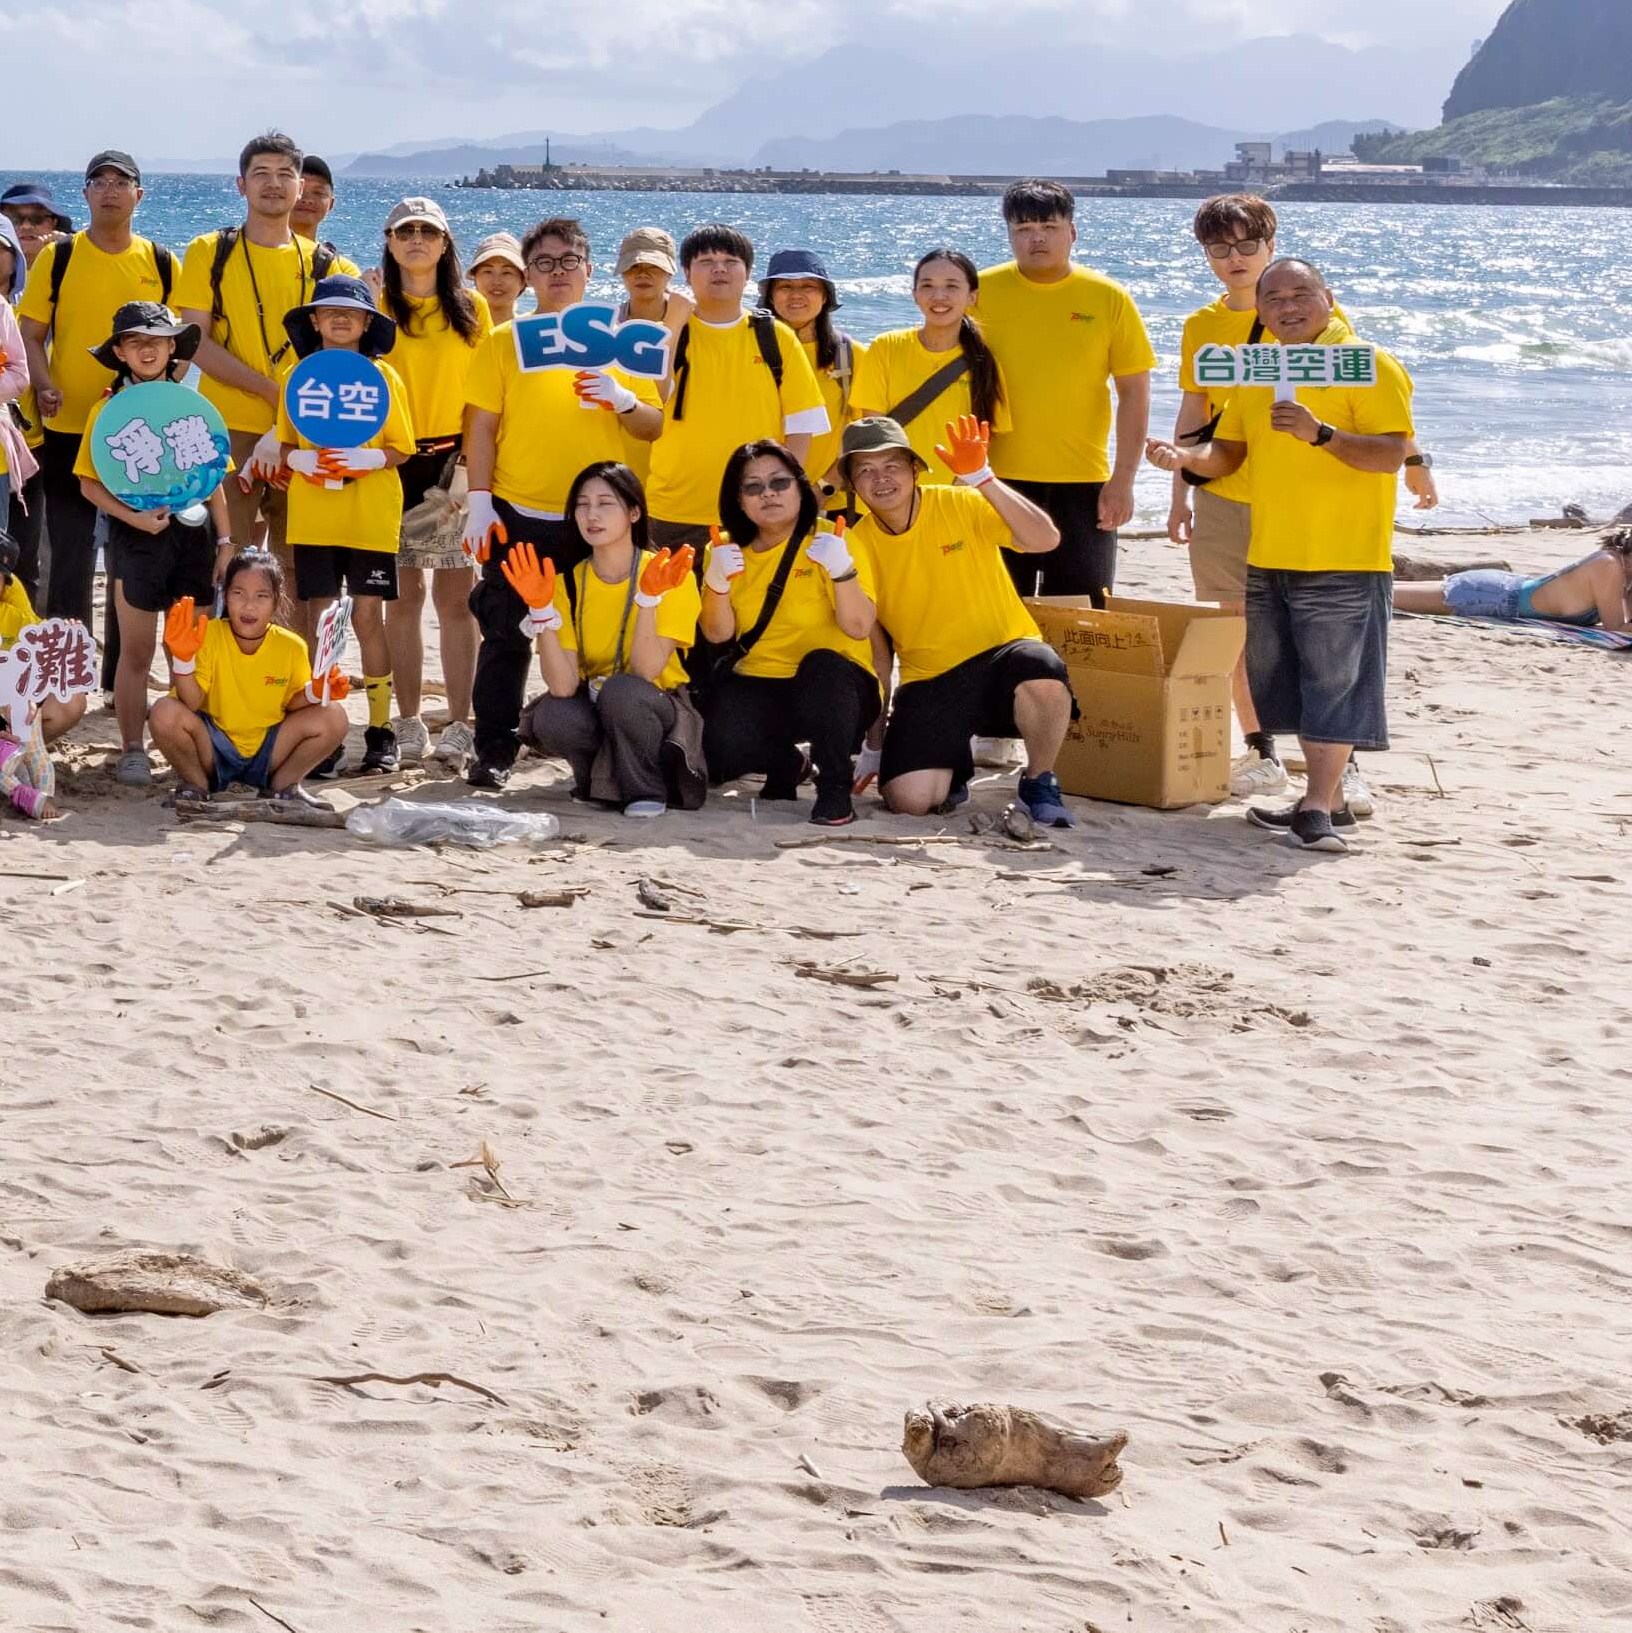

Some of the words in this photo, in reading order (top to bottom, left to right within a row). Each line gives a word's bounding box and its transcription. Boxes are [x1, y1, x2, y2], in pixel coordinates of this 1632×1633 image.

[516, 306, 667, 375] ESG
[1198, 348, 1372, 382] 台灣空運
[297, 377, 379, 422] 台空
[105, 416, 220, 484] 淨灘
[1064, 629, 1127, 650] 此面向上
